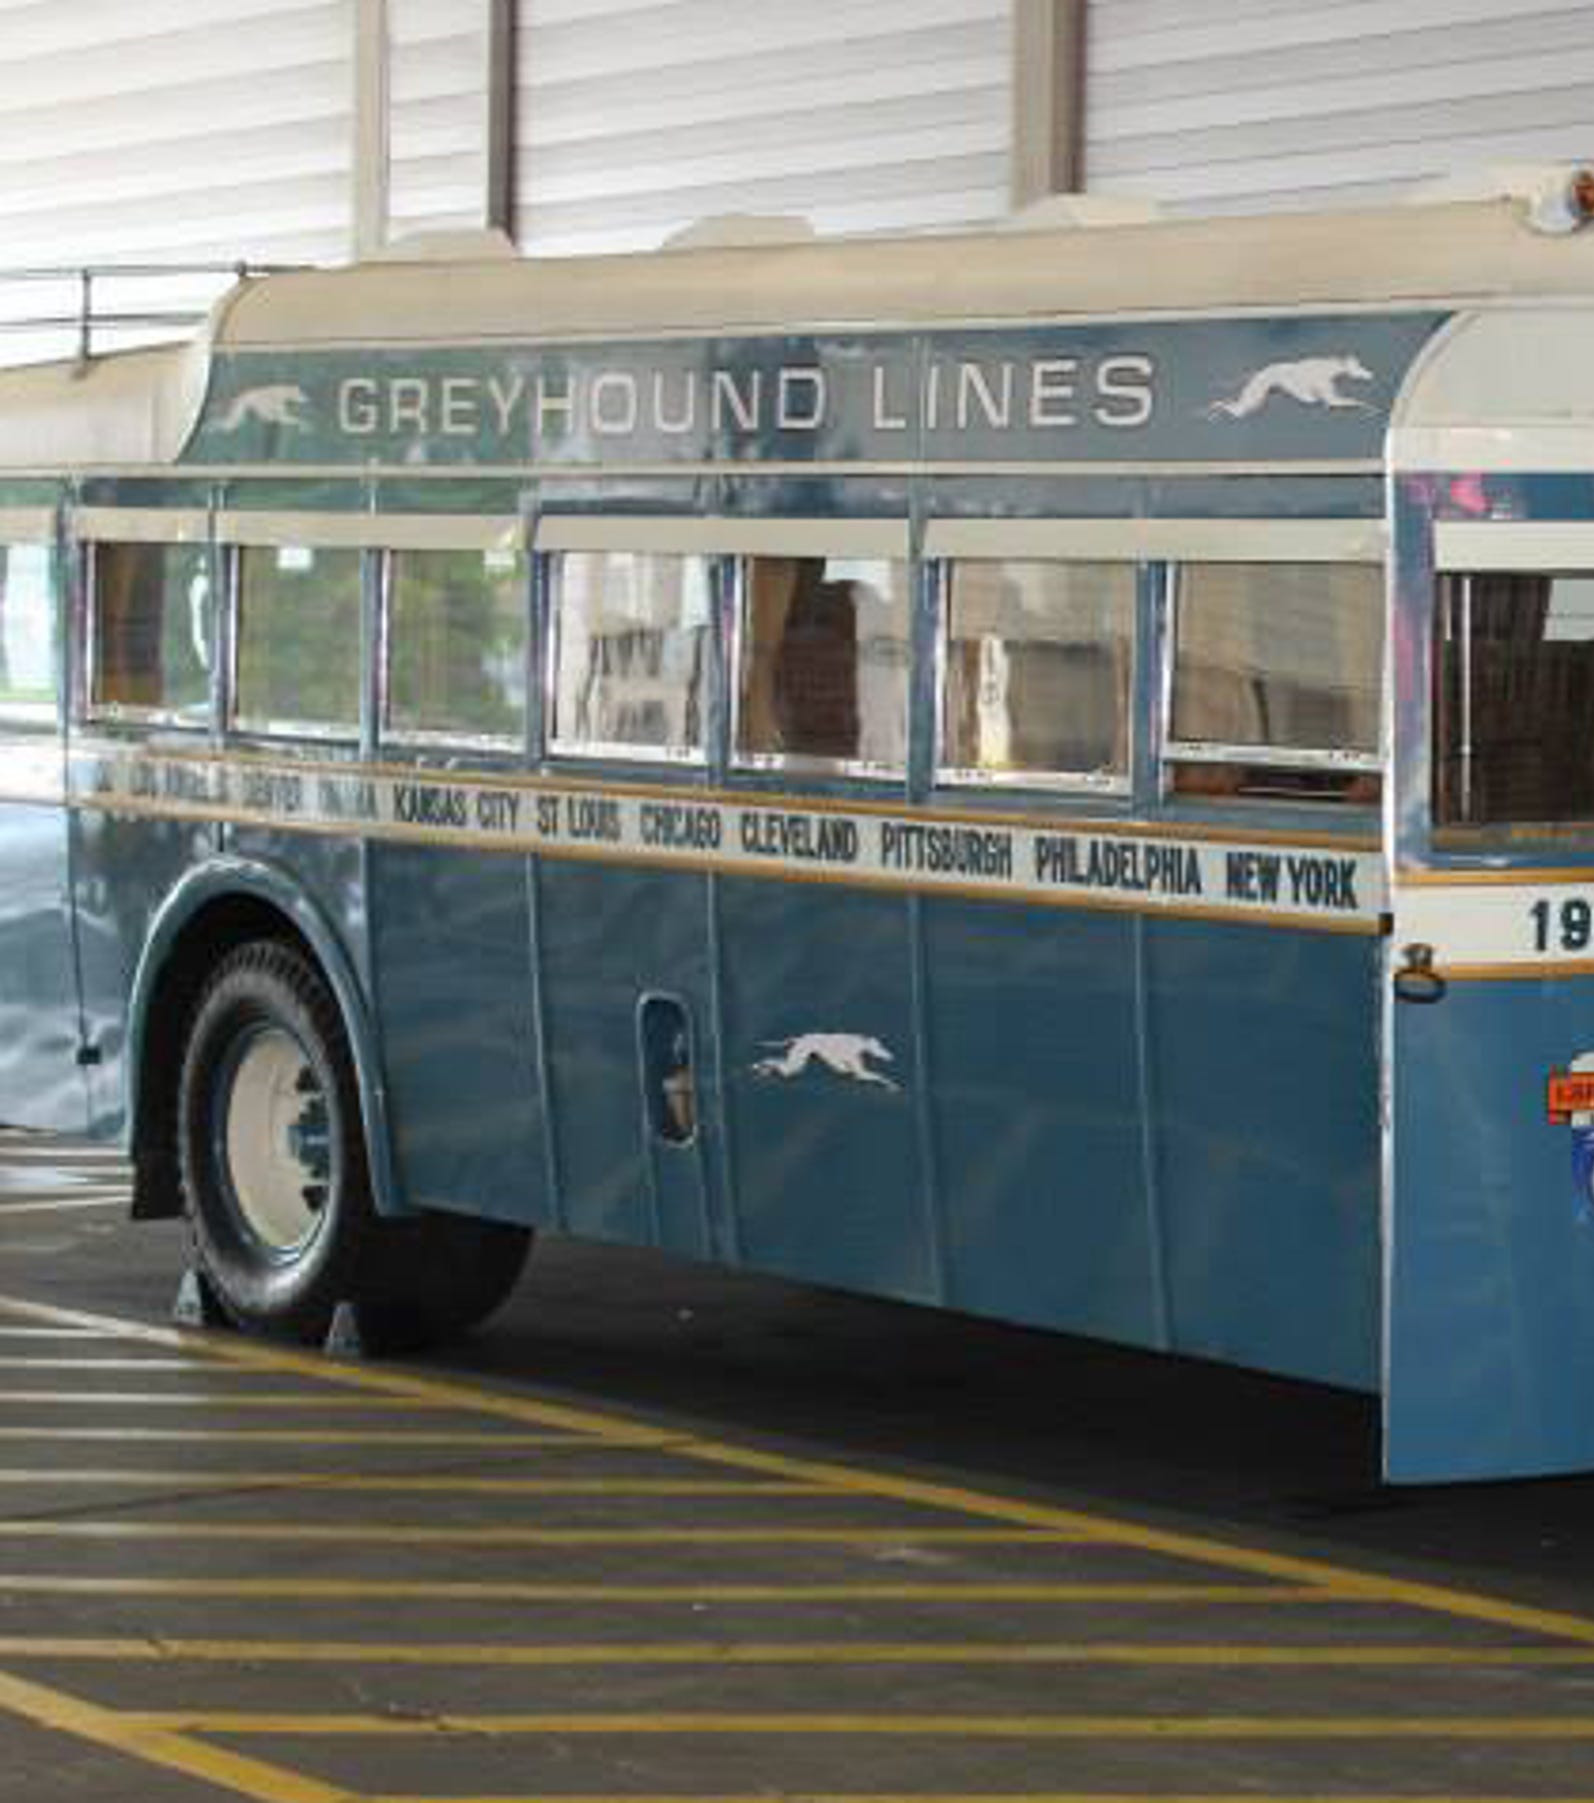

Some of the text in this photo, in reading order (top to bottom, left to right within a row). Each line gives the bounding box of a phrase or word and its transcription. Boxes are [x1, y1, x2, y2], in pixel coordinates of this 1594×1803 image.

[338, 356, 1154, 433] GREYHOUND LINES
[393, 784, 466, 826] KANSAS
[477, 790, 520, 831] CITY
[536, 796, 559, 834] ST
[567, 798, 621, 841] LOUIS
[639, 804, 722, 847] CHICAGO
[741, 813, 858, 861] CLEVELAND
[880, 821, 1012, 877] PITTSBURGH
[1034, 836, 1202, 894] PHILADELPHIA
[1225, 850, 1277, 901] NEW
[1281, 857, 1357, 908] YORK
